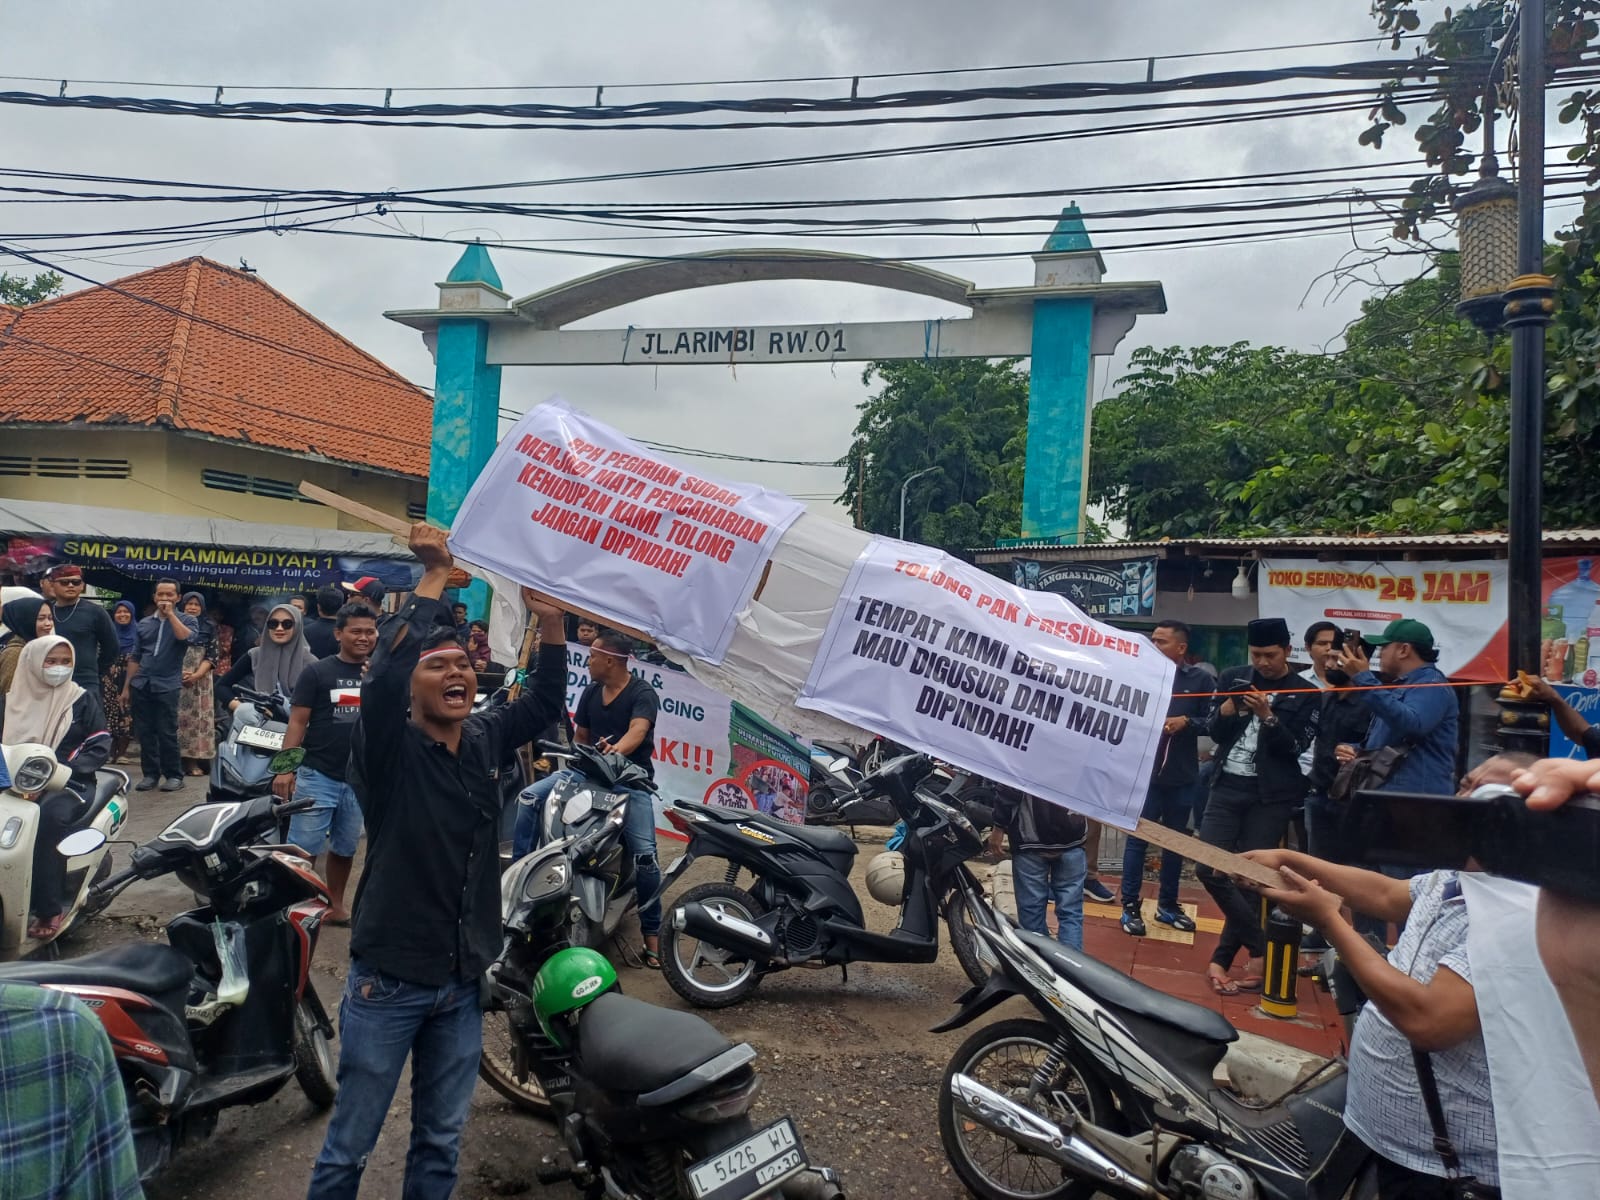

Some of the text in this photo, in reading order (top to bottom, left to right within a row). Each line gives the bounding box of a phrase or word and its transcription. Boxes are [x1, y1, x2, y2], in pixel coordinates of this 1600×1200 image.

[768, 328, 847, 354] RW.01
[591, 468, 646, 500] MATA
[643, 487, 768, 544] PENCAHARIAN
[602, 451, 682, 487] PEGIRIAN
[680, 476, 742, 507] SUDAH
[517, 462, 735, 563] KEHIDUPAN KAMI. TOLONG
[531, 502, 692, 578] JANGAN DIPINDAH!
[63, 541, 118, 558] SMP
[125, 546, 317, 569] MUHAMMADIYAH
[323, 557, 333, 570] 1
[127, 562, 171, 572] school
[182, 563, 238, 576] bilingual
[240, 567, 272, 576] class
[282, 568, 301, 577] full
[303, 569, 321, 578] AC
[1037, 571, 1082, 590] PANGKAS
[1267, 571, 1302, 587] TOKO
[1377, 571, 1490, 603] 24 JAM
[894, 559, 1141, 658] TOLONG PAK PRESIDEN!
[852, 629, 1129, 746] MAU DIGUSUR DAN MAU
[854, 595, 1151, 718] TEMPAT KAMI BERJUALAN
[915, 685, 1035, 752] DIPINDAH!
[695, 1127, 792, 1193] L 5426 WL
